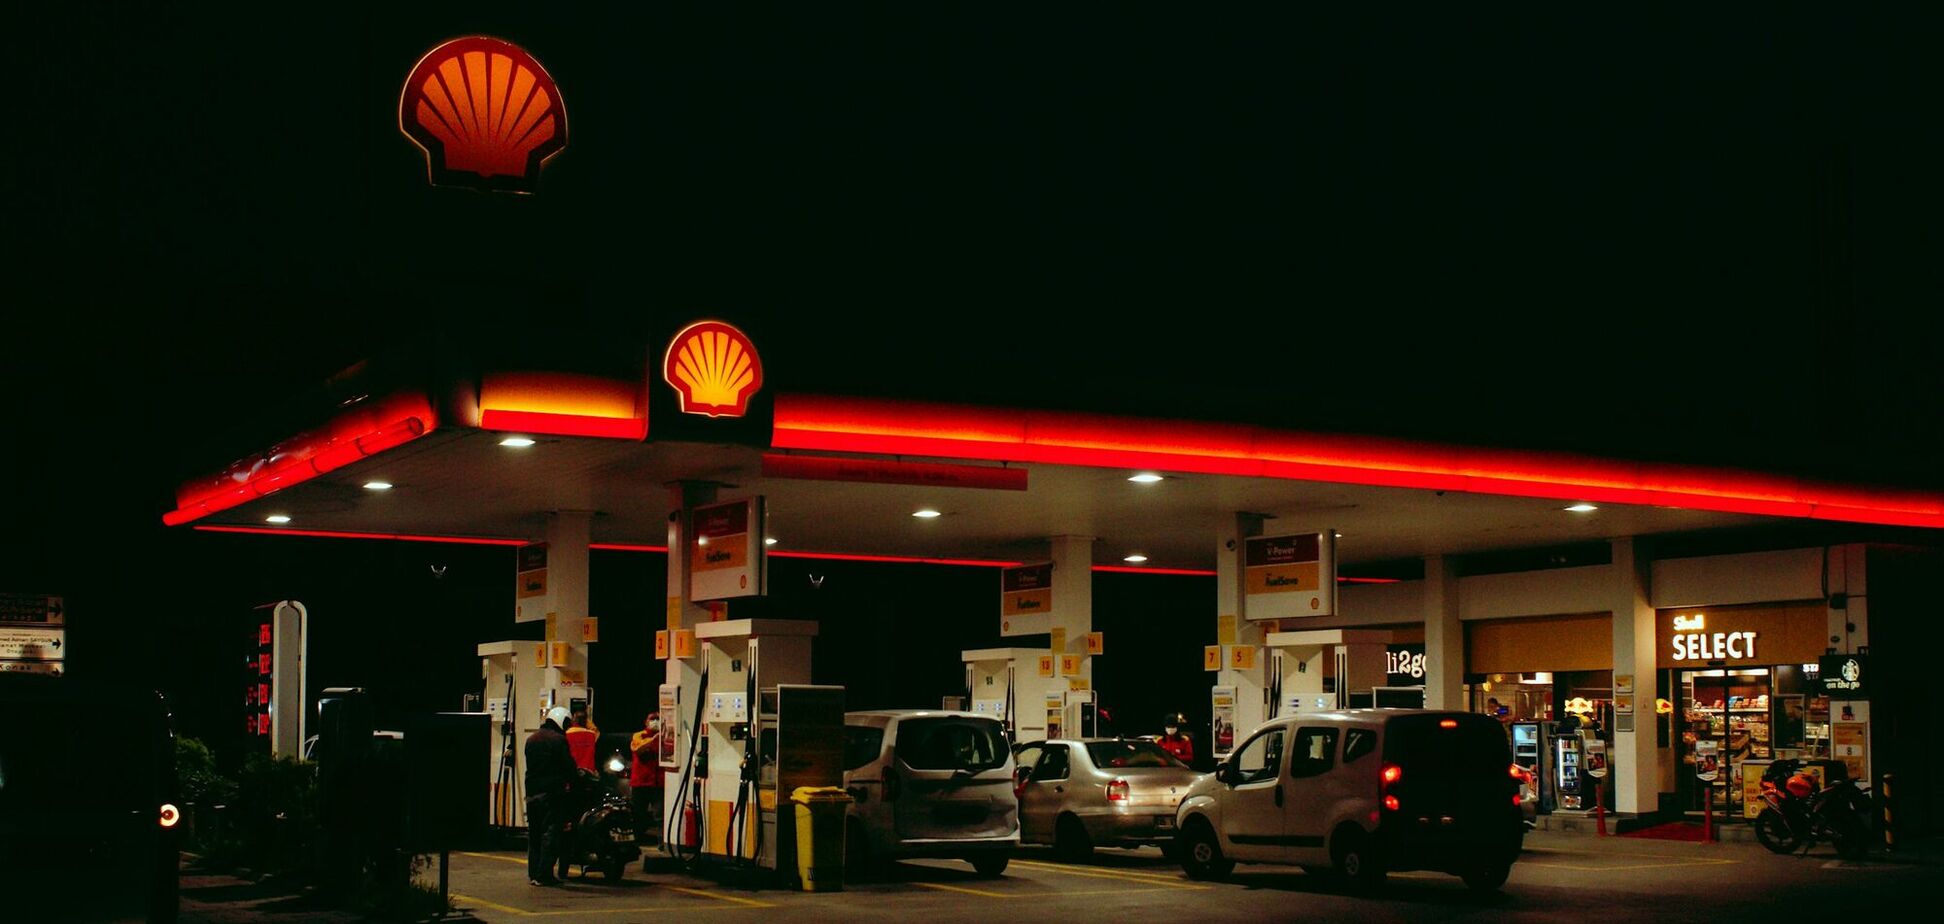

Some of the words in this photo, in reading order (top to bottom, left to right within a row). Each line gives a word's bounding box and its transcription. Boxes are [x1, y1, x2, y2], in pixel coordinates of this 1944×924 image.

[1673, 614, 1705, 631] Shell
[1672, 631, 1757, 661] SELECT
[1210, 652, 1214, 663] 7
[1236, 651, 1242, 662] 5
[1826, 682, 1837, 690] on
[1837, 680, 1849, 690] the
[1850, 681, 1861, 691] go
